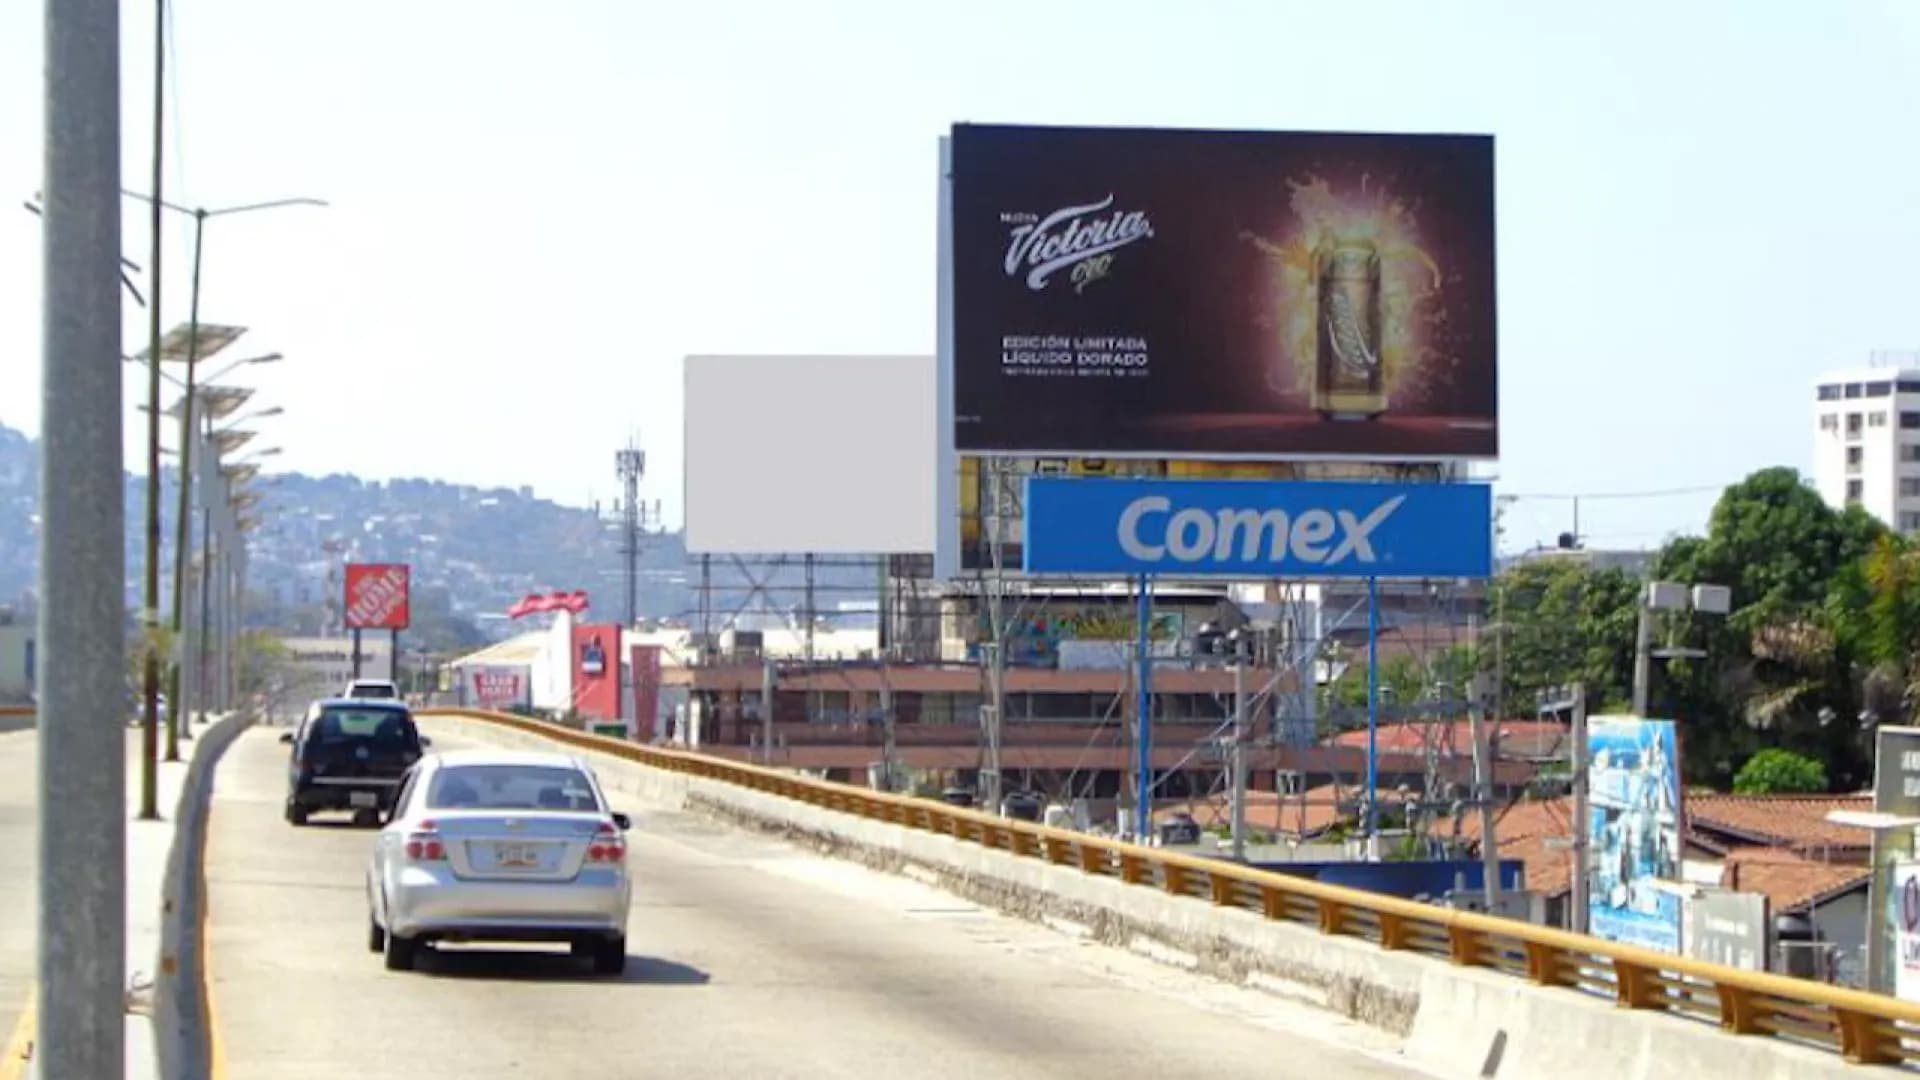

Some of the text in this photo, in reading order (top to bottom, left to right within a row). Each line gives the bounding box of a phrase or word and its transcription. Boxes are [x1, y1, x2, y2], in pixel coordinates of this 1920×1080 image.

[1004, 192, 1154, 290] Victoria
[1002, 335, 1148, 351] EDICIÓN LIMITADA
[1077, 352, 1148, 366] DORADO
[1117, 494, 1407, 565] Comex
